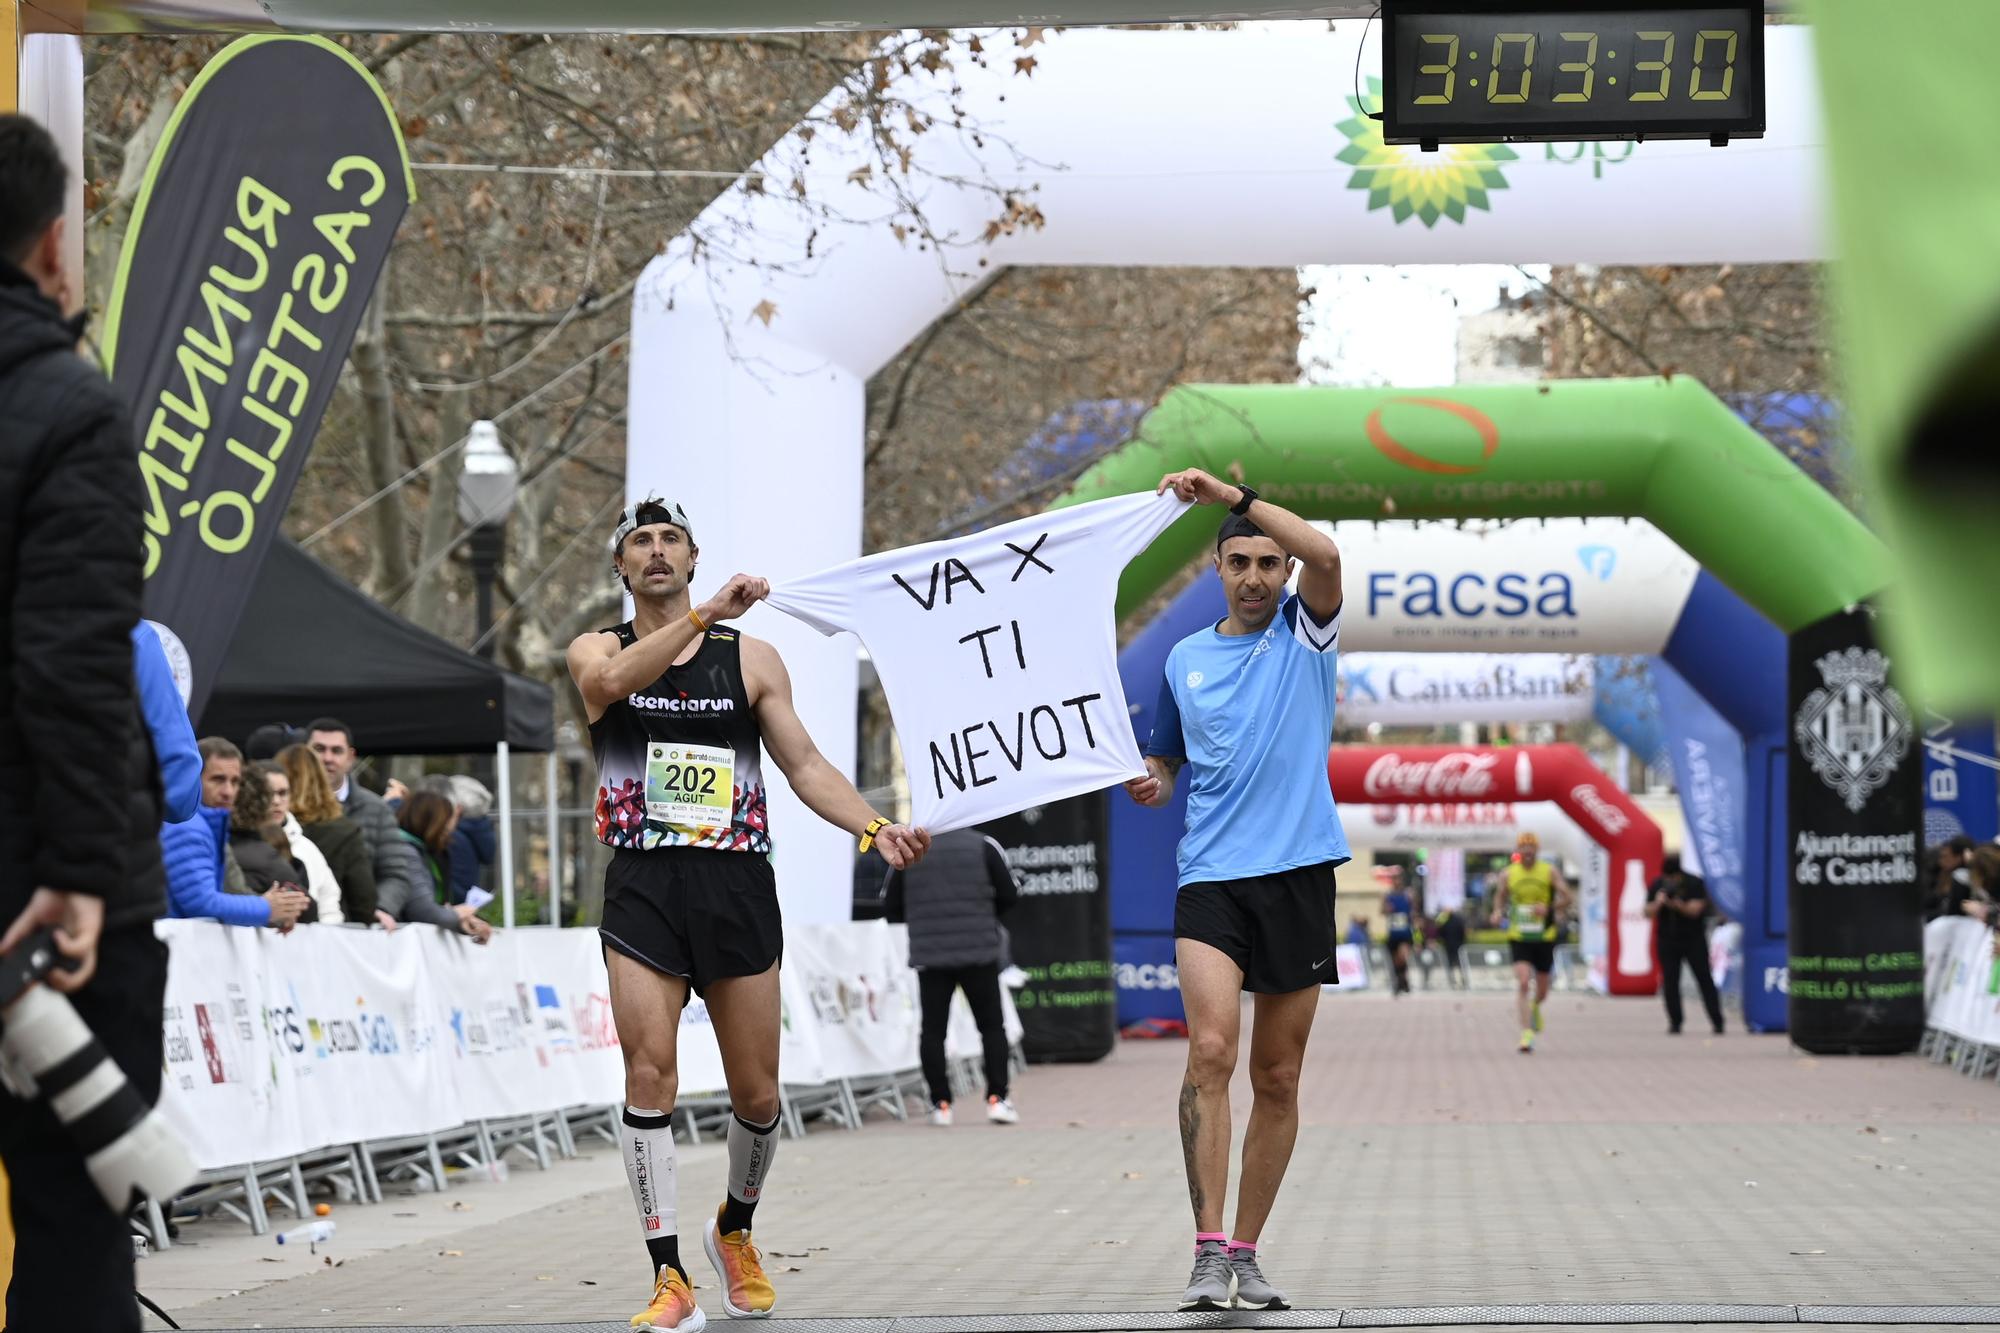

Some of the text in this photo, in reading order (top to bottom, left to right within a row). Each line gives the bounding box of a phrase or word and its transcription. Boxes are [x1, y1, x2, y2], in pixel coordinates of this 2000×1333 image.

[1413, 30, 1737, 104] 3:03:30
[892, 532, 1055, 611] VA X
[958, 620, 1026, 678] TI
[929, 693, 1101, 799] NEVOT
[664, 764, 717, 795] 202
[674, 792, 705, 804] AGUT
[1796, 830, 1916, 863] Ajuntament
